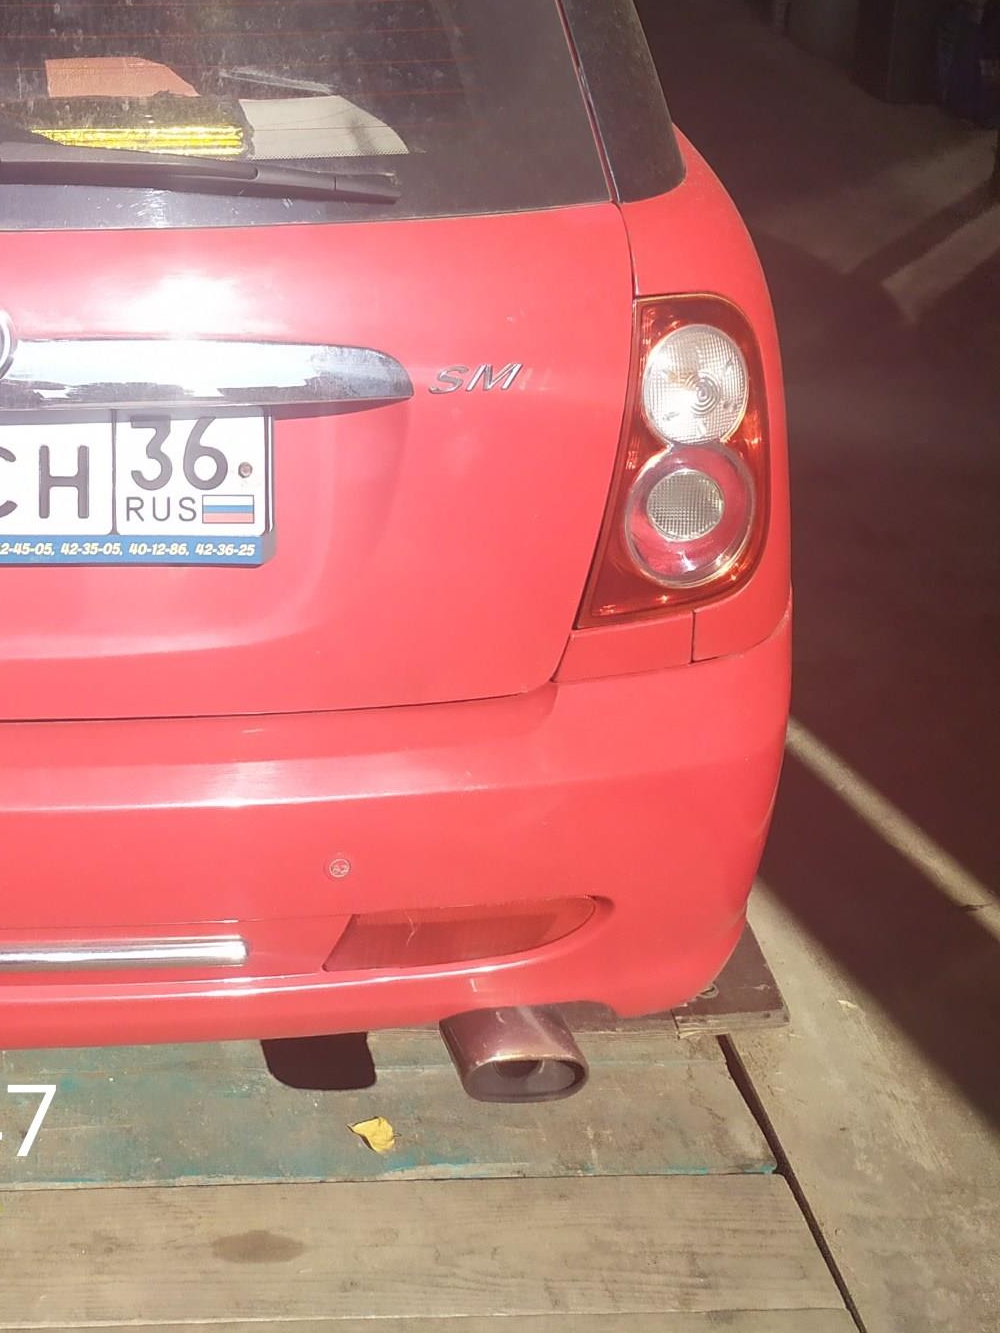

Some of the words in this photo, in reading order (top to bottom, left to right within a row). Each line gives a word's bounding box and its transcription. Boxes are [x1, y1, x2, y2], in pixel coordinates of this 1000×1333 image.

[428, 362, 523, 394] SM
[131, 414, 228, 491] 36
[125, 496, 197, 523] RUS
[60, 543, 123, 557] 42-35-05,
[128, 543, 189, 557] 40-12-86,
[195, 543, 255, 556] 42-36-25
